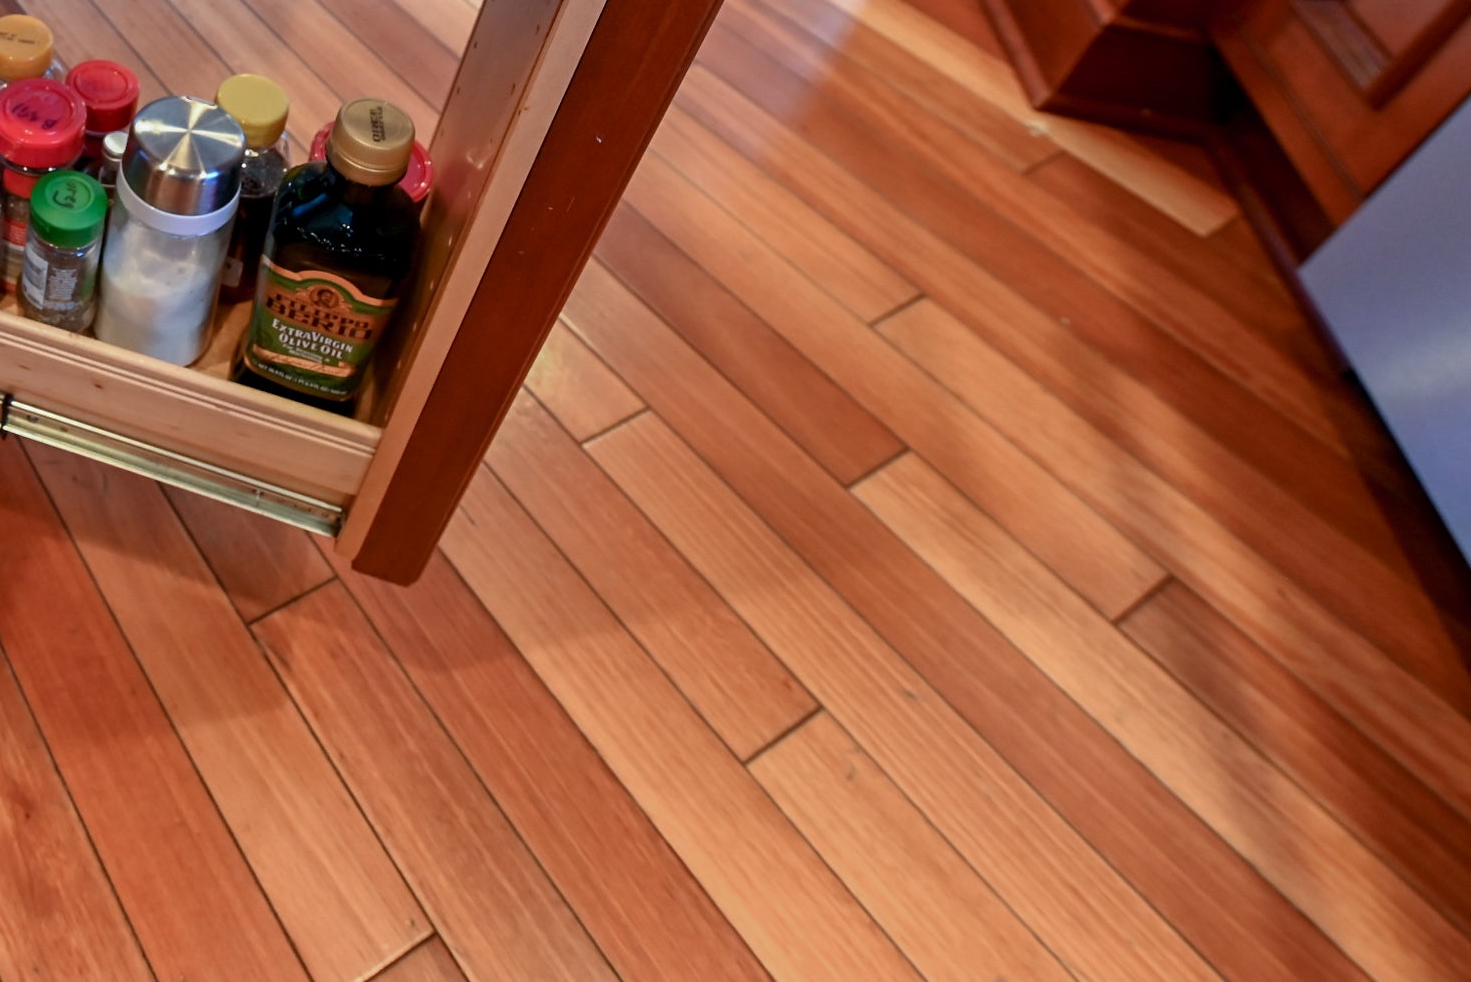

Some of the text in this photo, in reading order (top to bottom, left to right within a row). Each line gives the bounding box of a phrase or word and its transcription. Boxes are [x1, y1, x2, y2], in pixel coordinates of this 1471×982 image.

[266, 296, 373, 341] BERIO
[275, 294, 370, 329] FILIPPO
[320, 343, 344, 360] OIL
